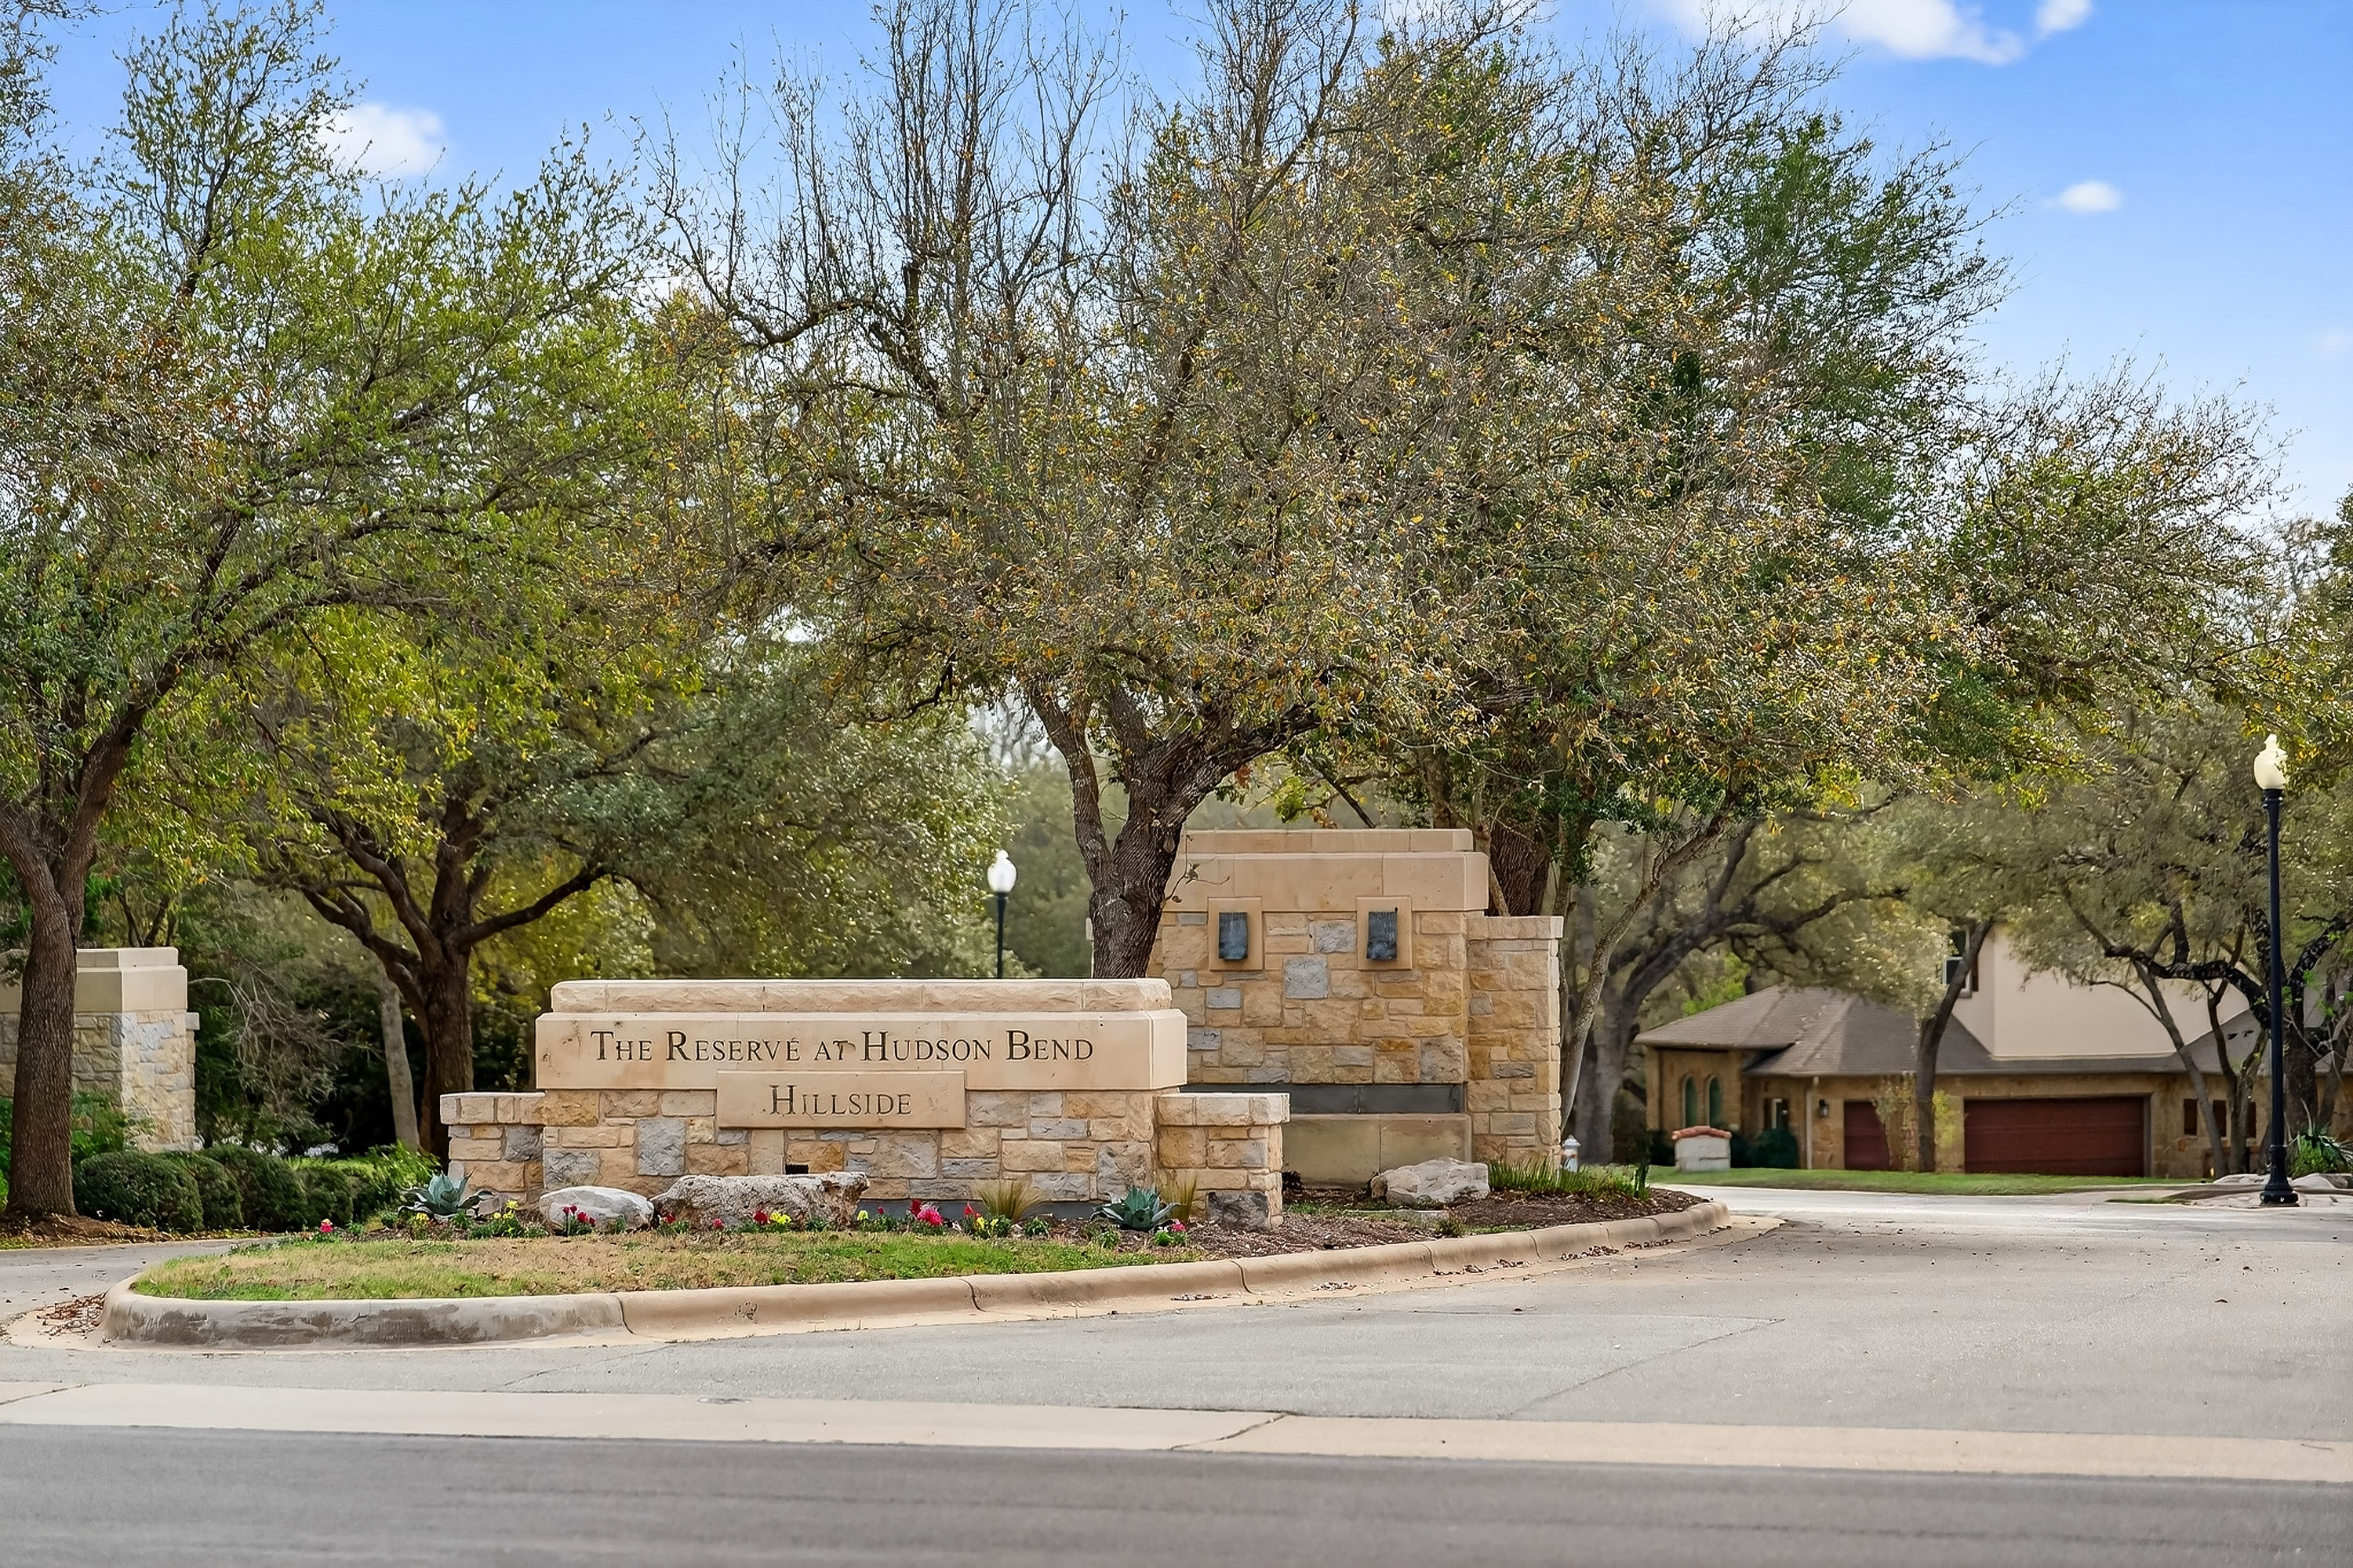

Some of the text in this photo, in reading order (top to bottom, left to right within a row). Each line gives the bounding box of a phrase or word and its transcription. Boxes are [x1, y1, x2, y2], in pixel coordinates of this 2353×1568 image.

[590, 1030, 1093, 1062] THE RESERVE AT HUDSON BEND
[769, 1085, 911, 1115] HILLSIDE
